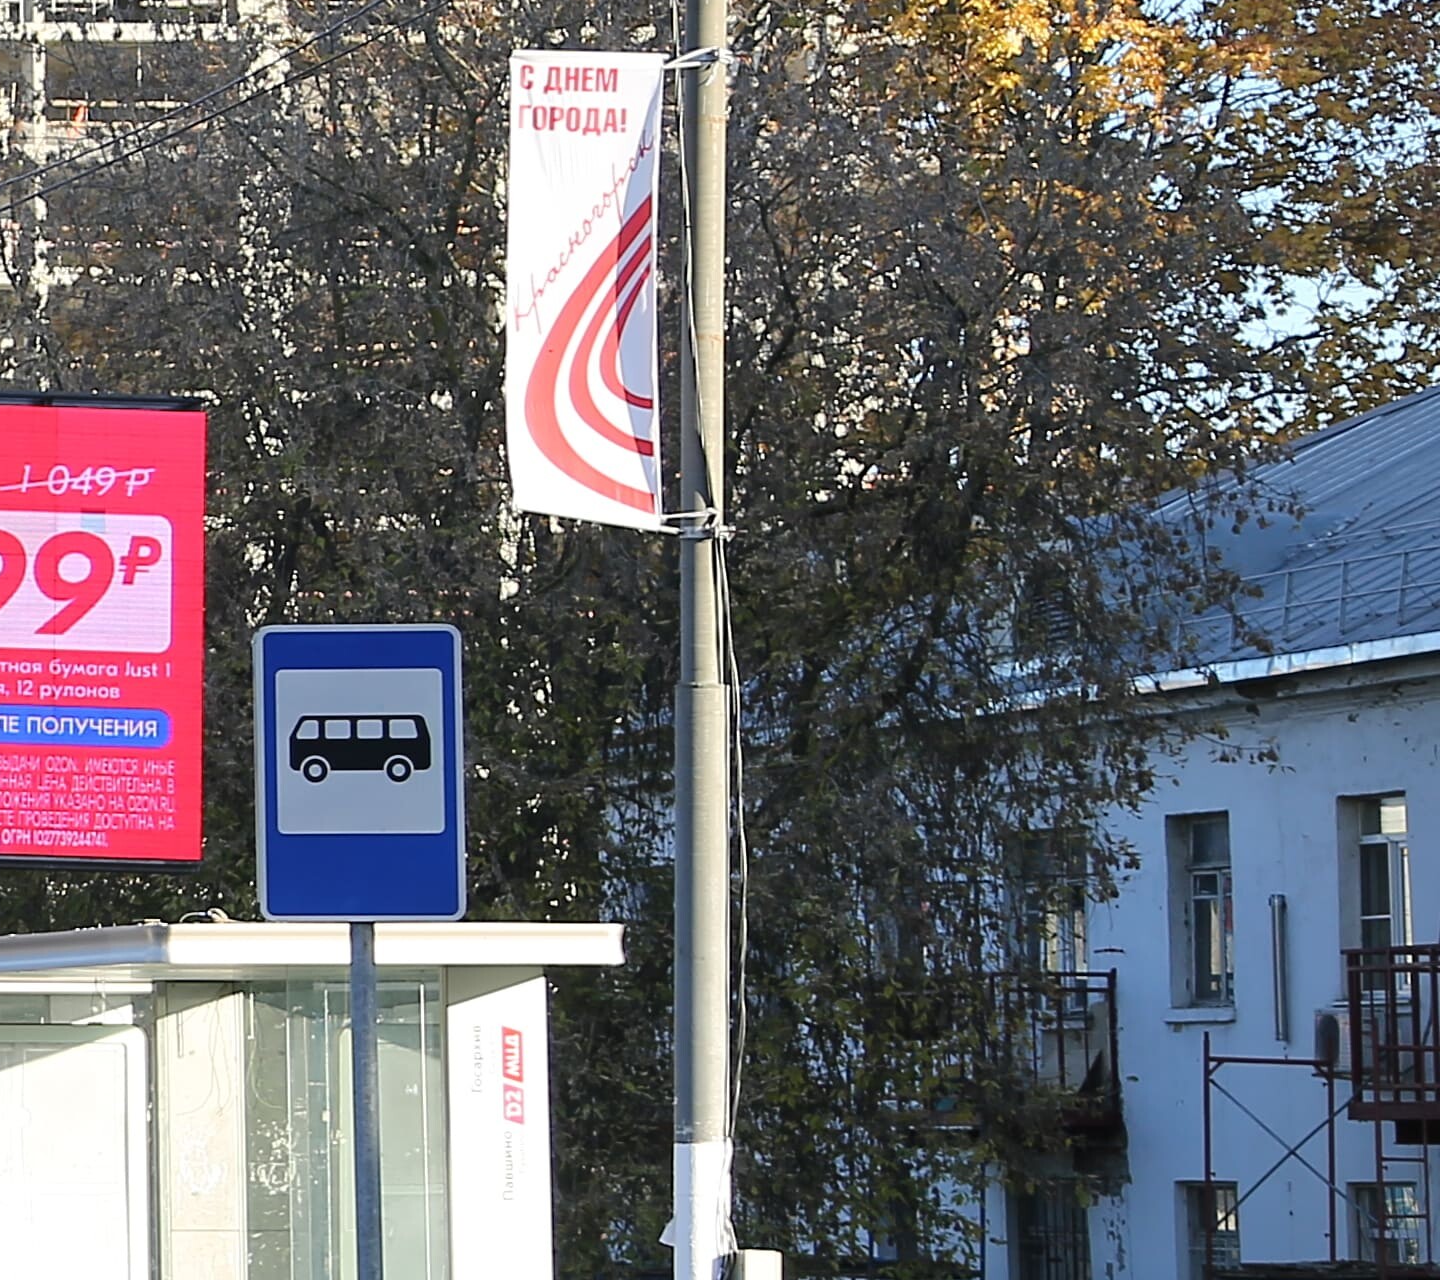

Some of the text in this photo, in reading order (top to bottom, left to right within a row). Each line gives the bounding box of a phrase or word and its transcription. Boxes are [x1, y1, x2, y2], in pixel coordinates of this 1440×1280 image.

[519, 64, 619, 94] С ДНЕМ
[518, 104, 627, 135] ГОРОДА!
[49, 658, 118, 678] бумага
[17, 681, 33, 696] 12
[40, 683, 121, 703] рулонов
[27, 716, 158, 738] ПОЛУЧЕНИЯ
